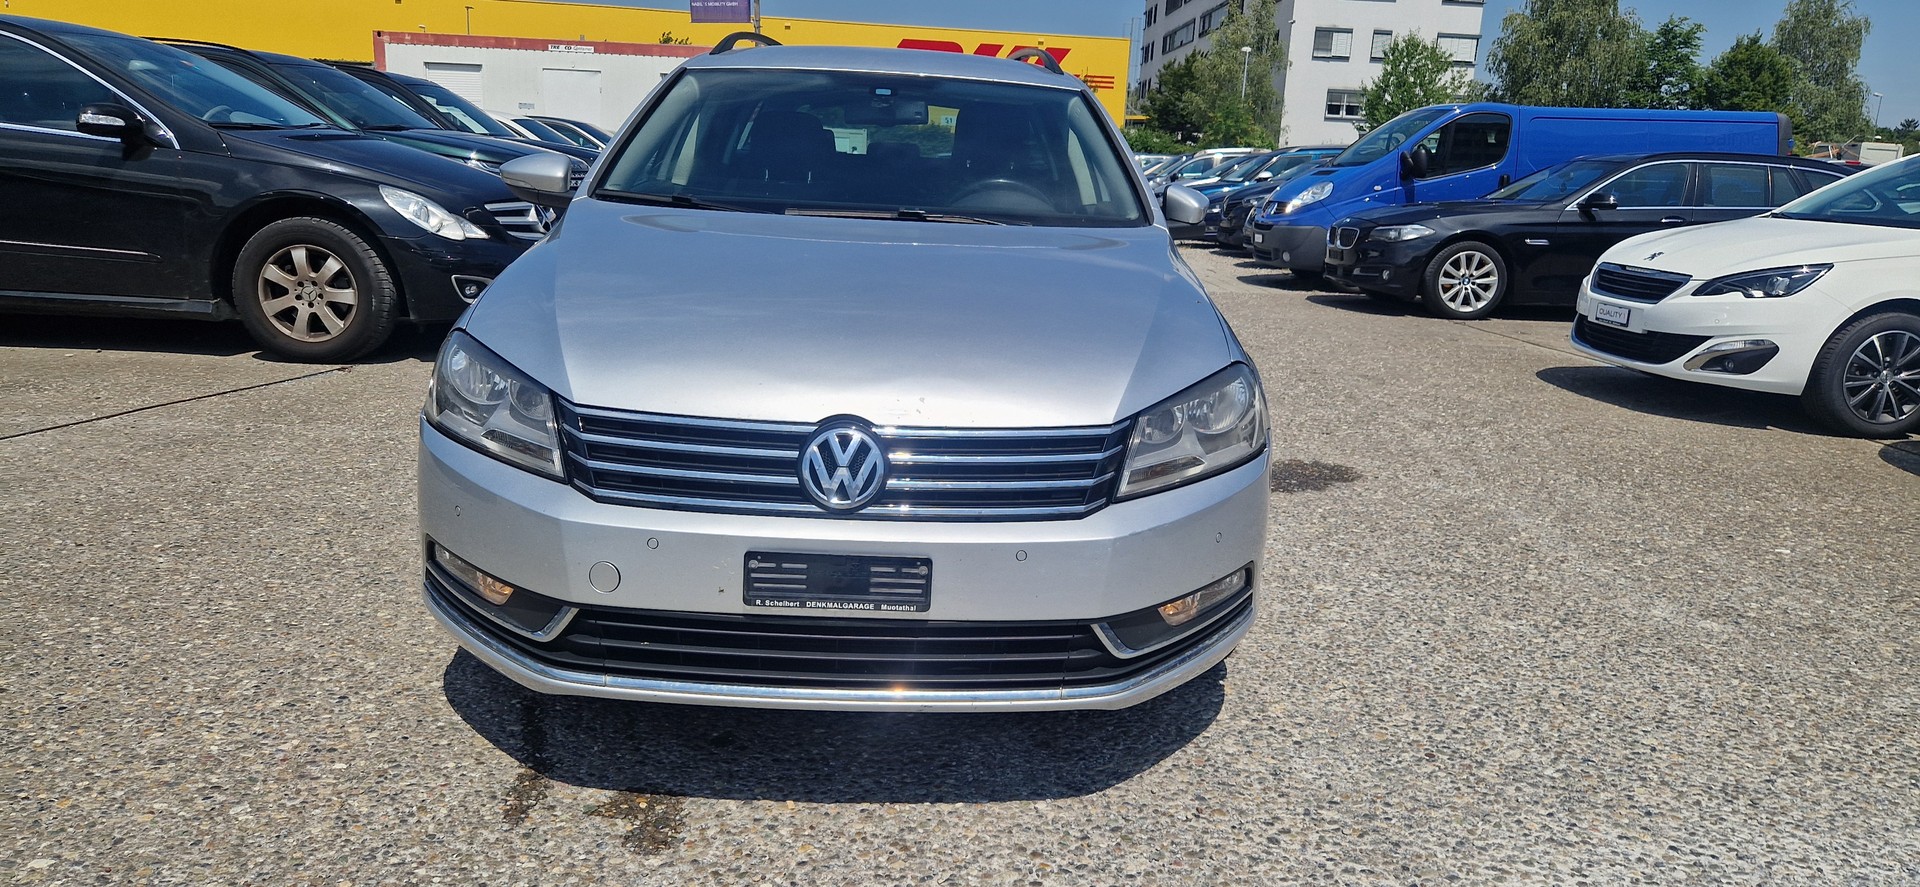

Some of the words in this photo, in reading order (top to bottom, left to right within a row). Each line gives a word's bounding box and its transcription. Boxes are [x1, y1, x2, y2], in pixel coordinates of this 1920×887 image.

[803, 429, 884, 509] VW
[806, 600, 875, 610] DENKMALGARAGE
[880, 603, 917, 612] Muotathal
